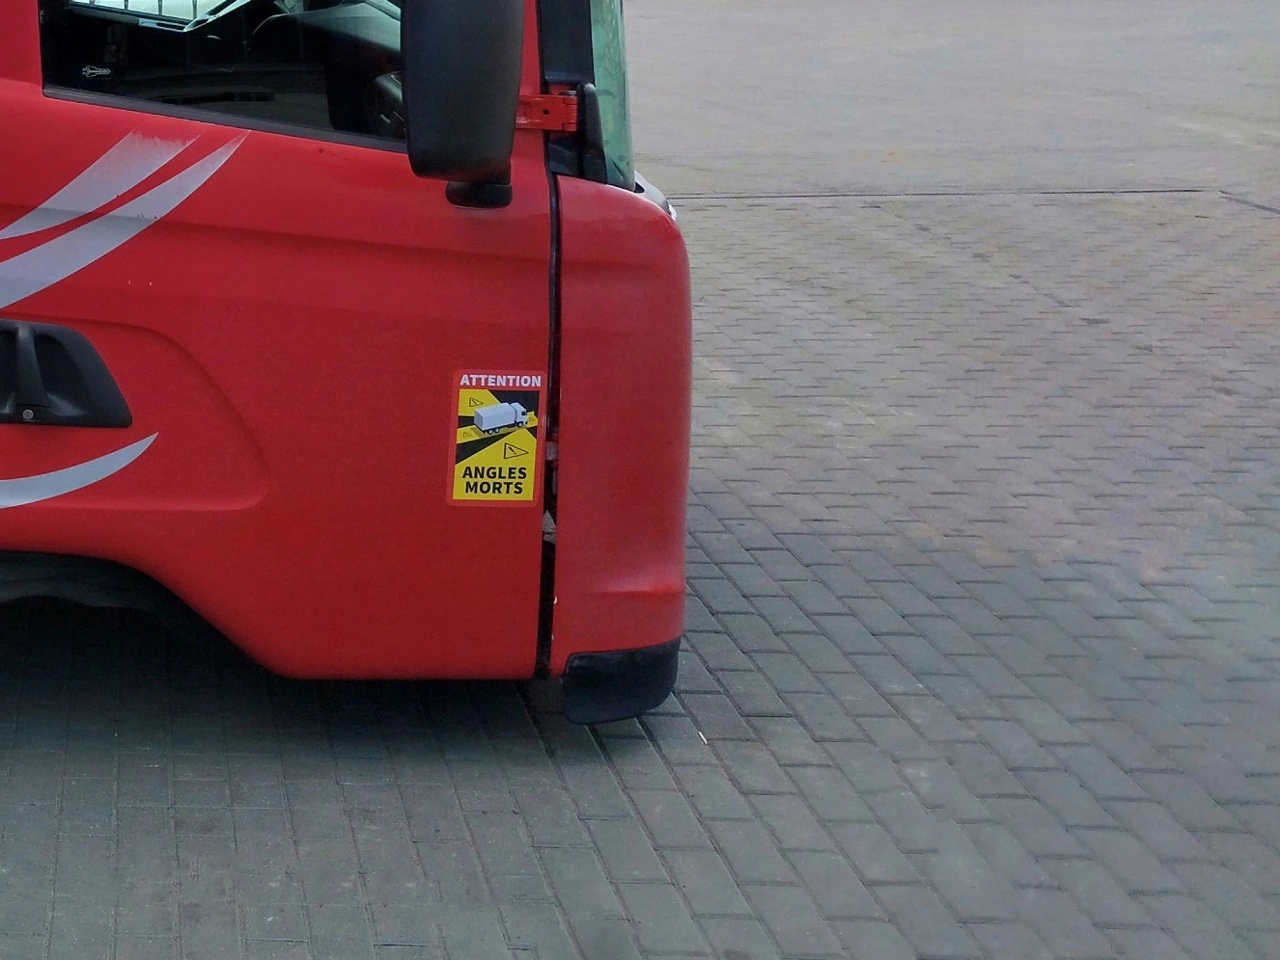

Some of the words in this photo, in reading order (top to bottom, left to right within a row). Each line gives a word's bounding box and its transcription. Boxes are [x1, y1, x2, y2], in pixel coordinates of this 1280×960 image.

[460, 374, 541, 387] ATTENTION
[462, 466, 527, 480] ANGLES
[465, 481, 523, 495] MORTS
